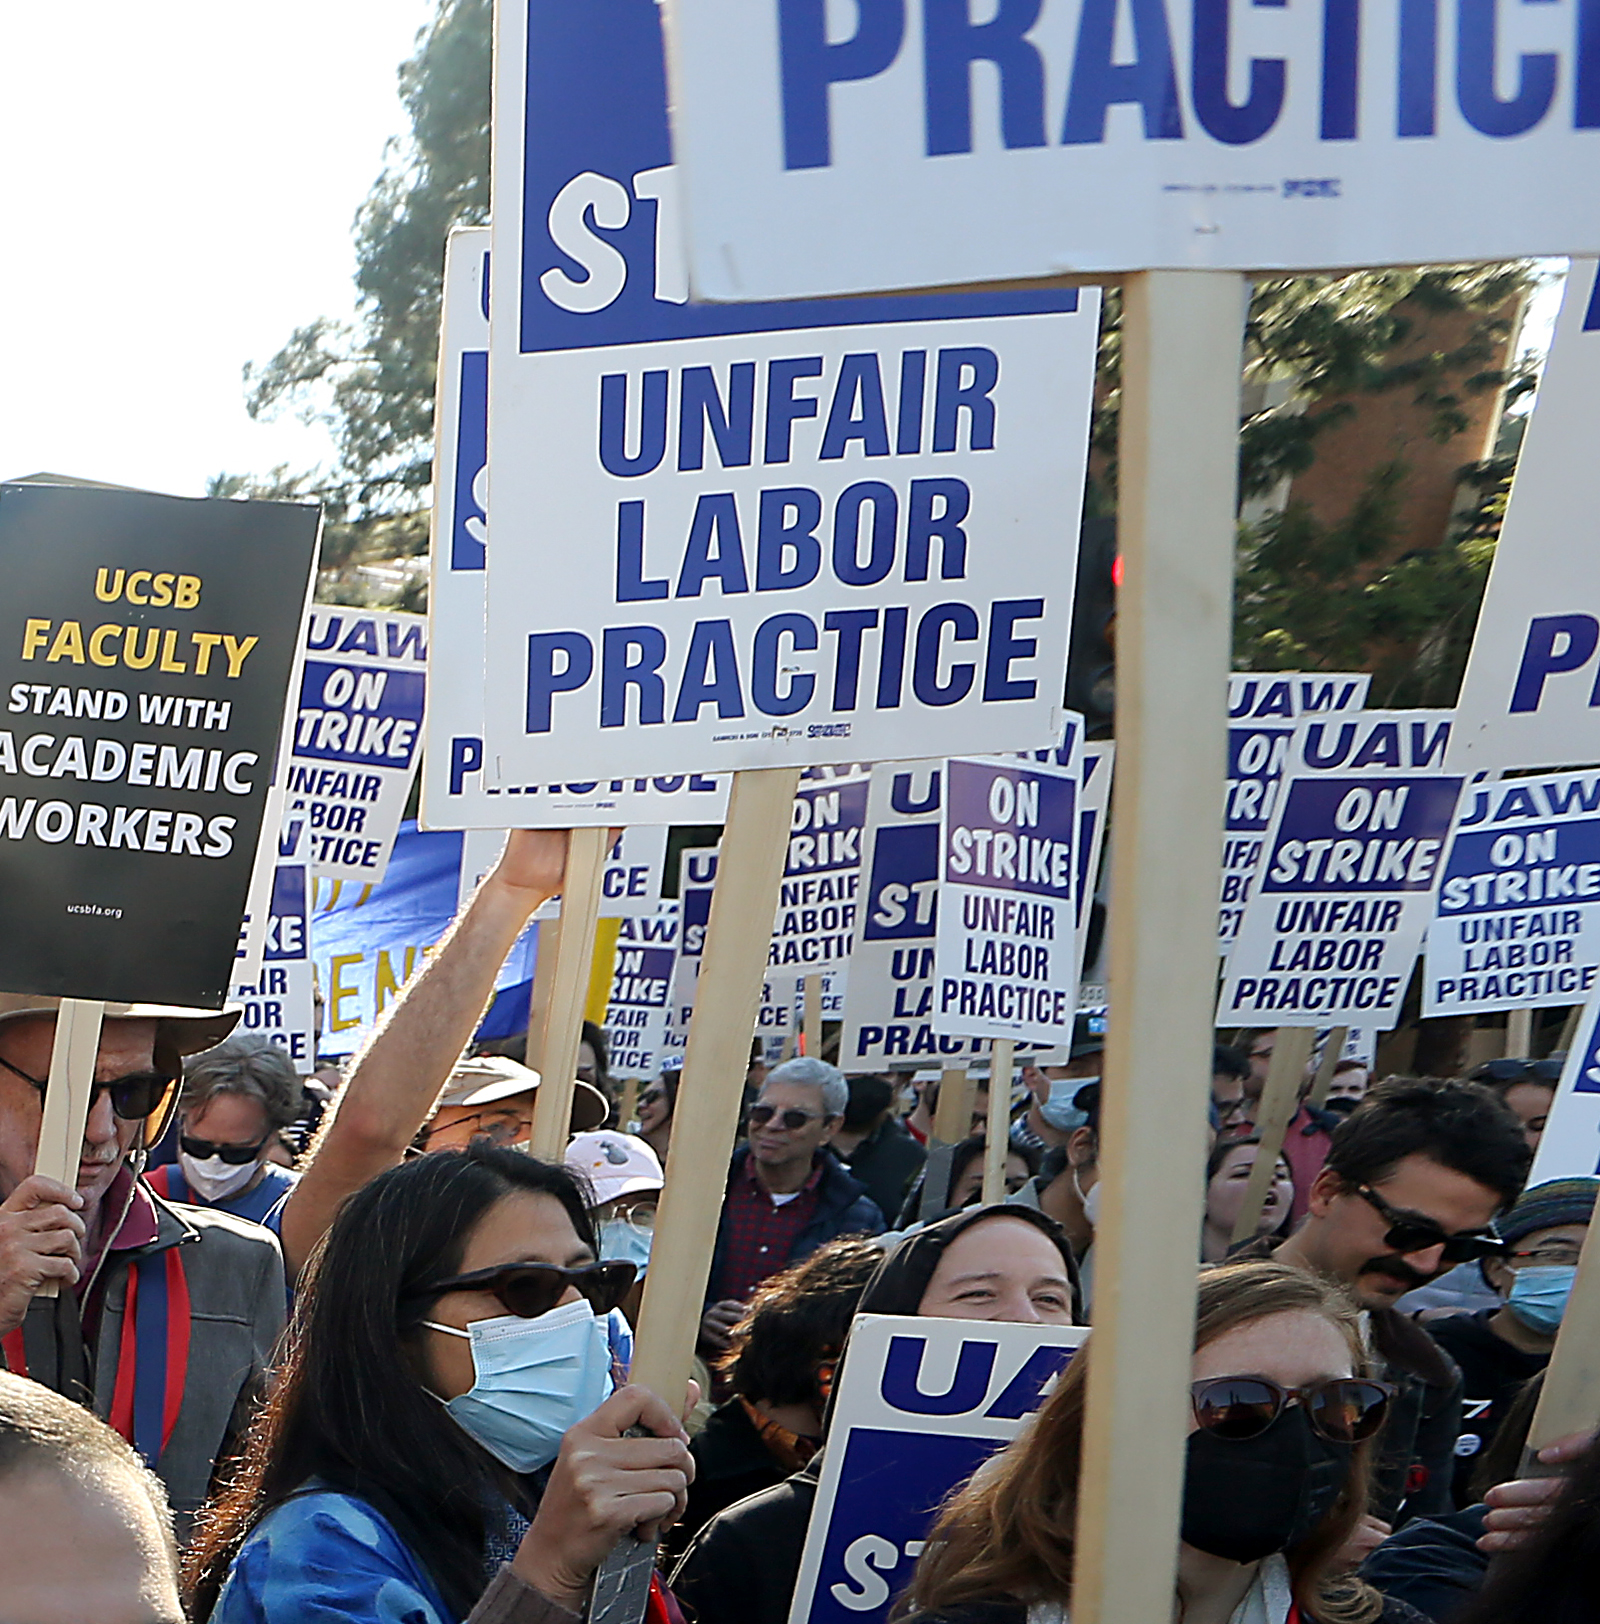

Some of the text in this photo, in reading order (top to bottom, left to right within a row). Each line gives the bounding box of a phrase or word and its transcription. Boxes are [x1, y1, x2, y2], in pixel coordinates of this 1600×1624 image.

[598, 345, 1001, 480] UNFAIR
[614, 477, 971, 604] LABOR
[95, 566, 202, 611] UCSB
[21, 617, 260, 681] FACULTY
[524, 597, 1048, 735] PRACTICE
[7, 683, 233, 732] STAND WITH
[322, 667, 388, 712] ON
[988, 775, 1040, 829] ON
[1334, 785, 1410, 833] ON
[949, 825, 1071, 889] STRIKE
[1269, 837, 1442, 886] STRIKE
[1489, 827, 1559, 868] ON
[1440, 862, 1600, 911] STRIKE
[66, 902, 124, 920] ucsbfa.org
[963, 893, 1055, 941] UNFAIR
[1275, 899, 1404, 935] UNFAIR
[1459, 910, 1583, 945] UNFAIR
[964, 937, 1050, 982] LABOR
[1267, 938, 1386, 973] LABOR
[1464, 939, 1575, 974] LABOR
[940, 978, 1066, 1026] PRACTICE
[1231, 975, 1401, 1011] PRACTICE
[1436, 965, 1599, 1005] PRACTICE
